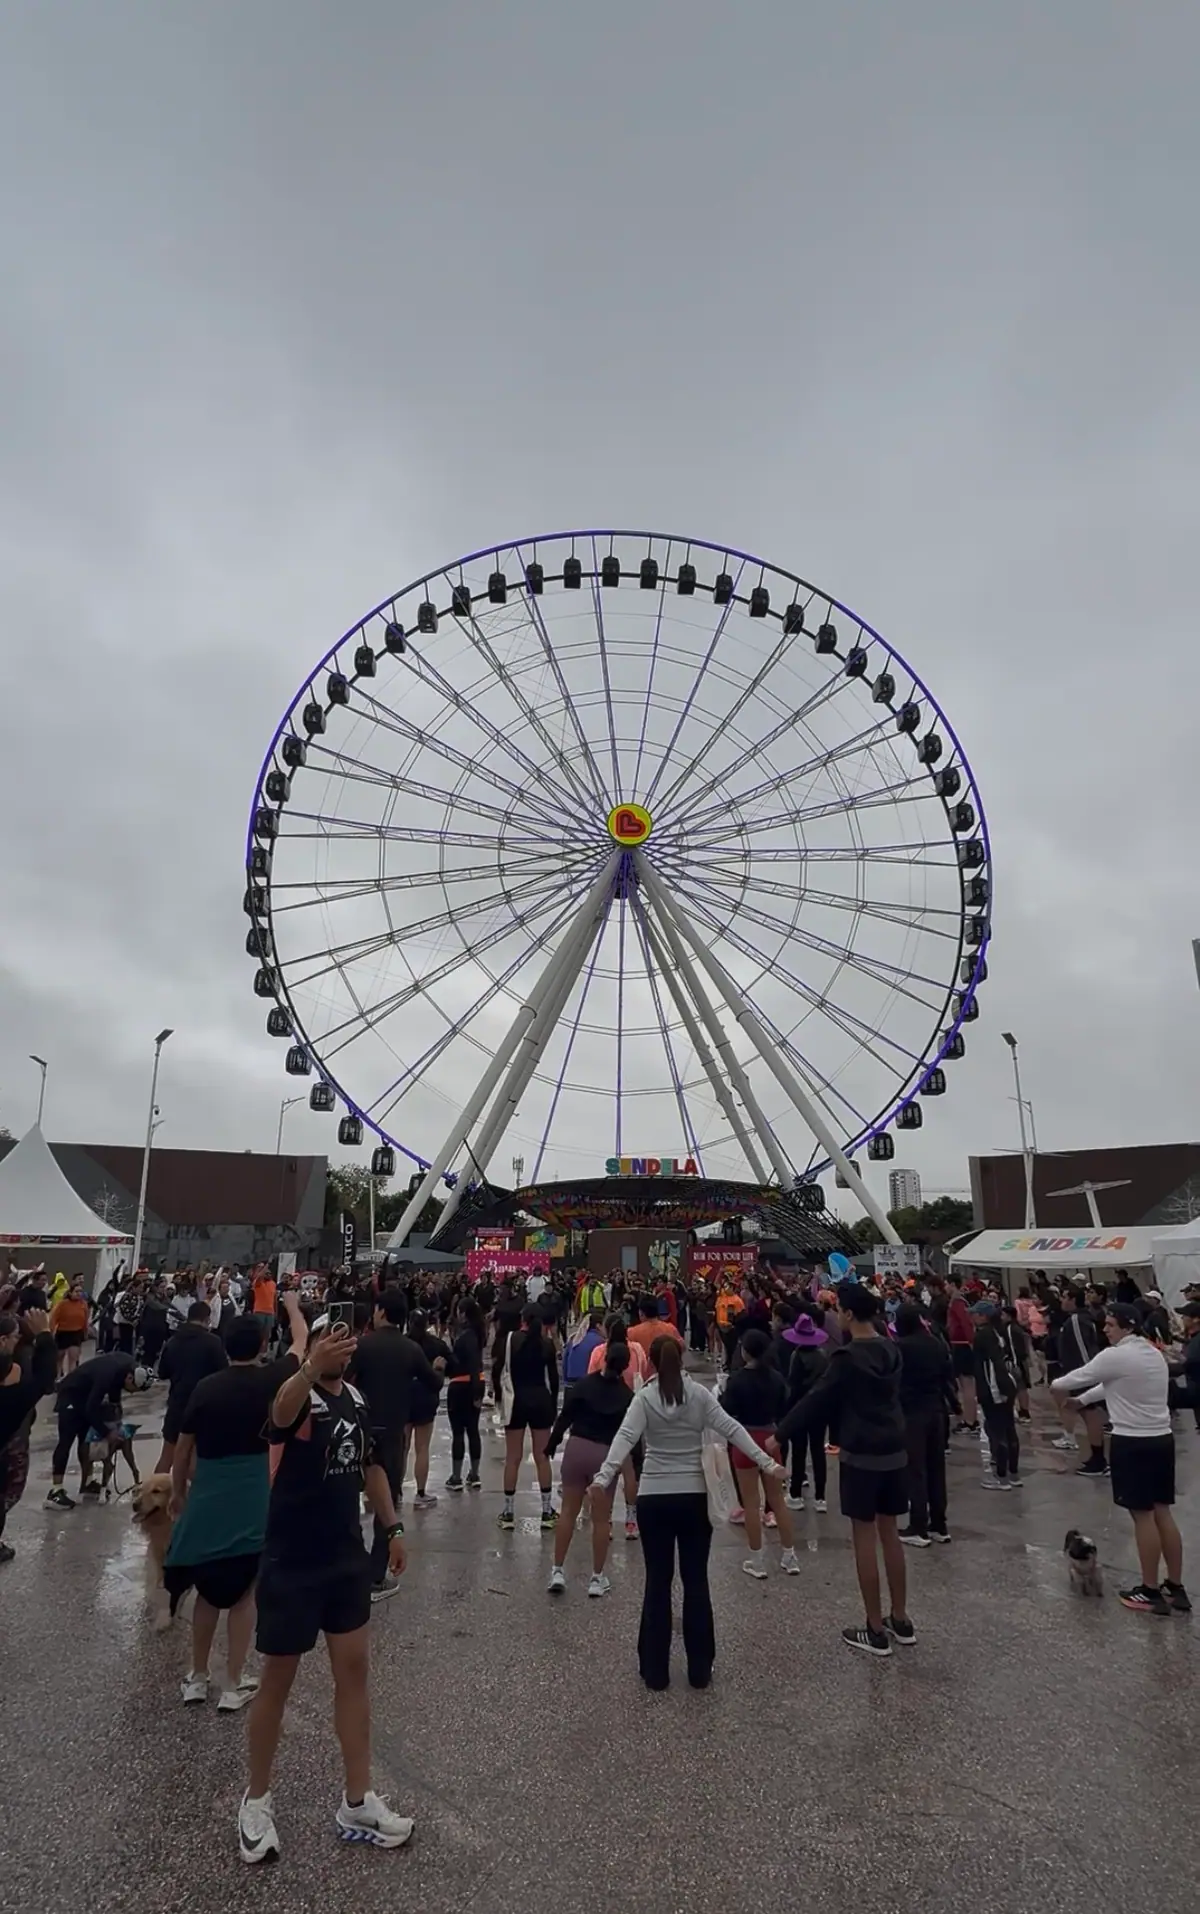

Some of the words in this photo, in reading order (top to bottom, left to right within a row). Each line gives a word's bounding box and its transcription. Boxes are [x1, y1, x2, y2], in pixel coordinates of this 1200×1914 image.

[605, 1158, 698, 1175] SENDELA
[999, 1237, 1127, 1251] SENDELA
[707, 1252, 721, 1261] FOR
